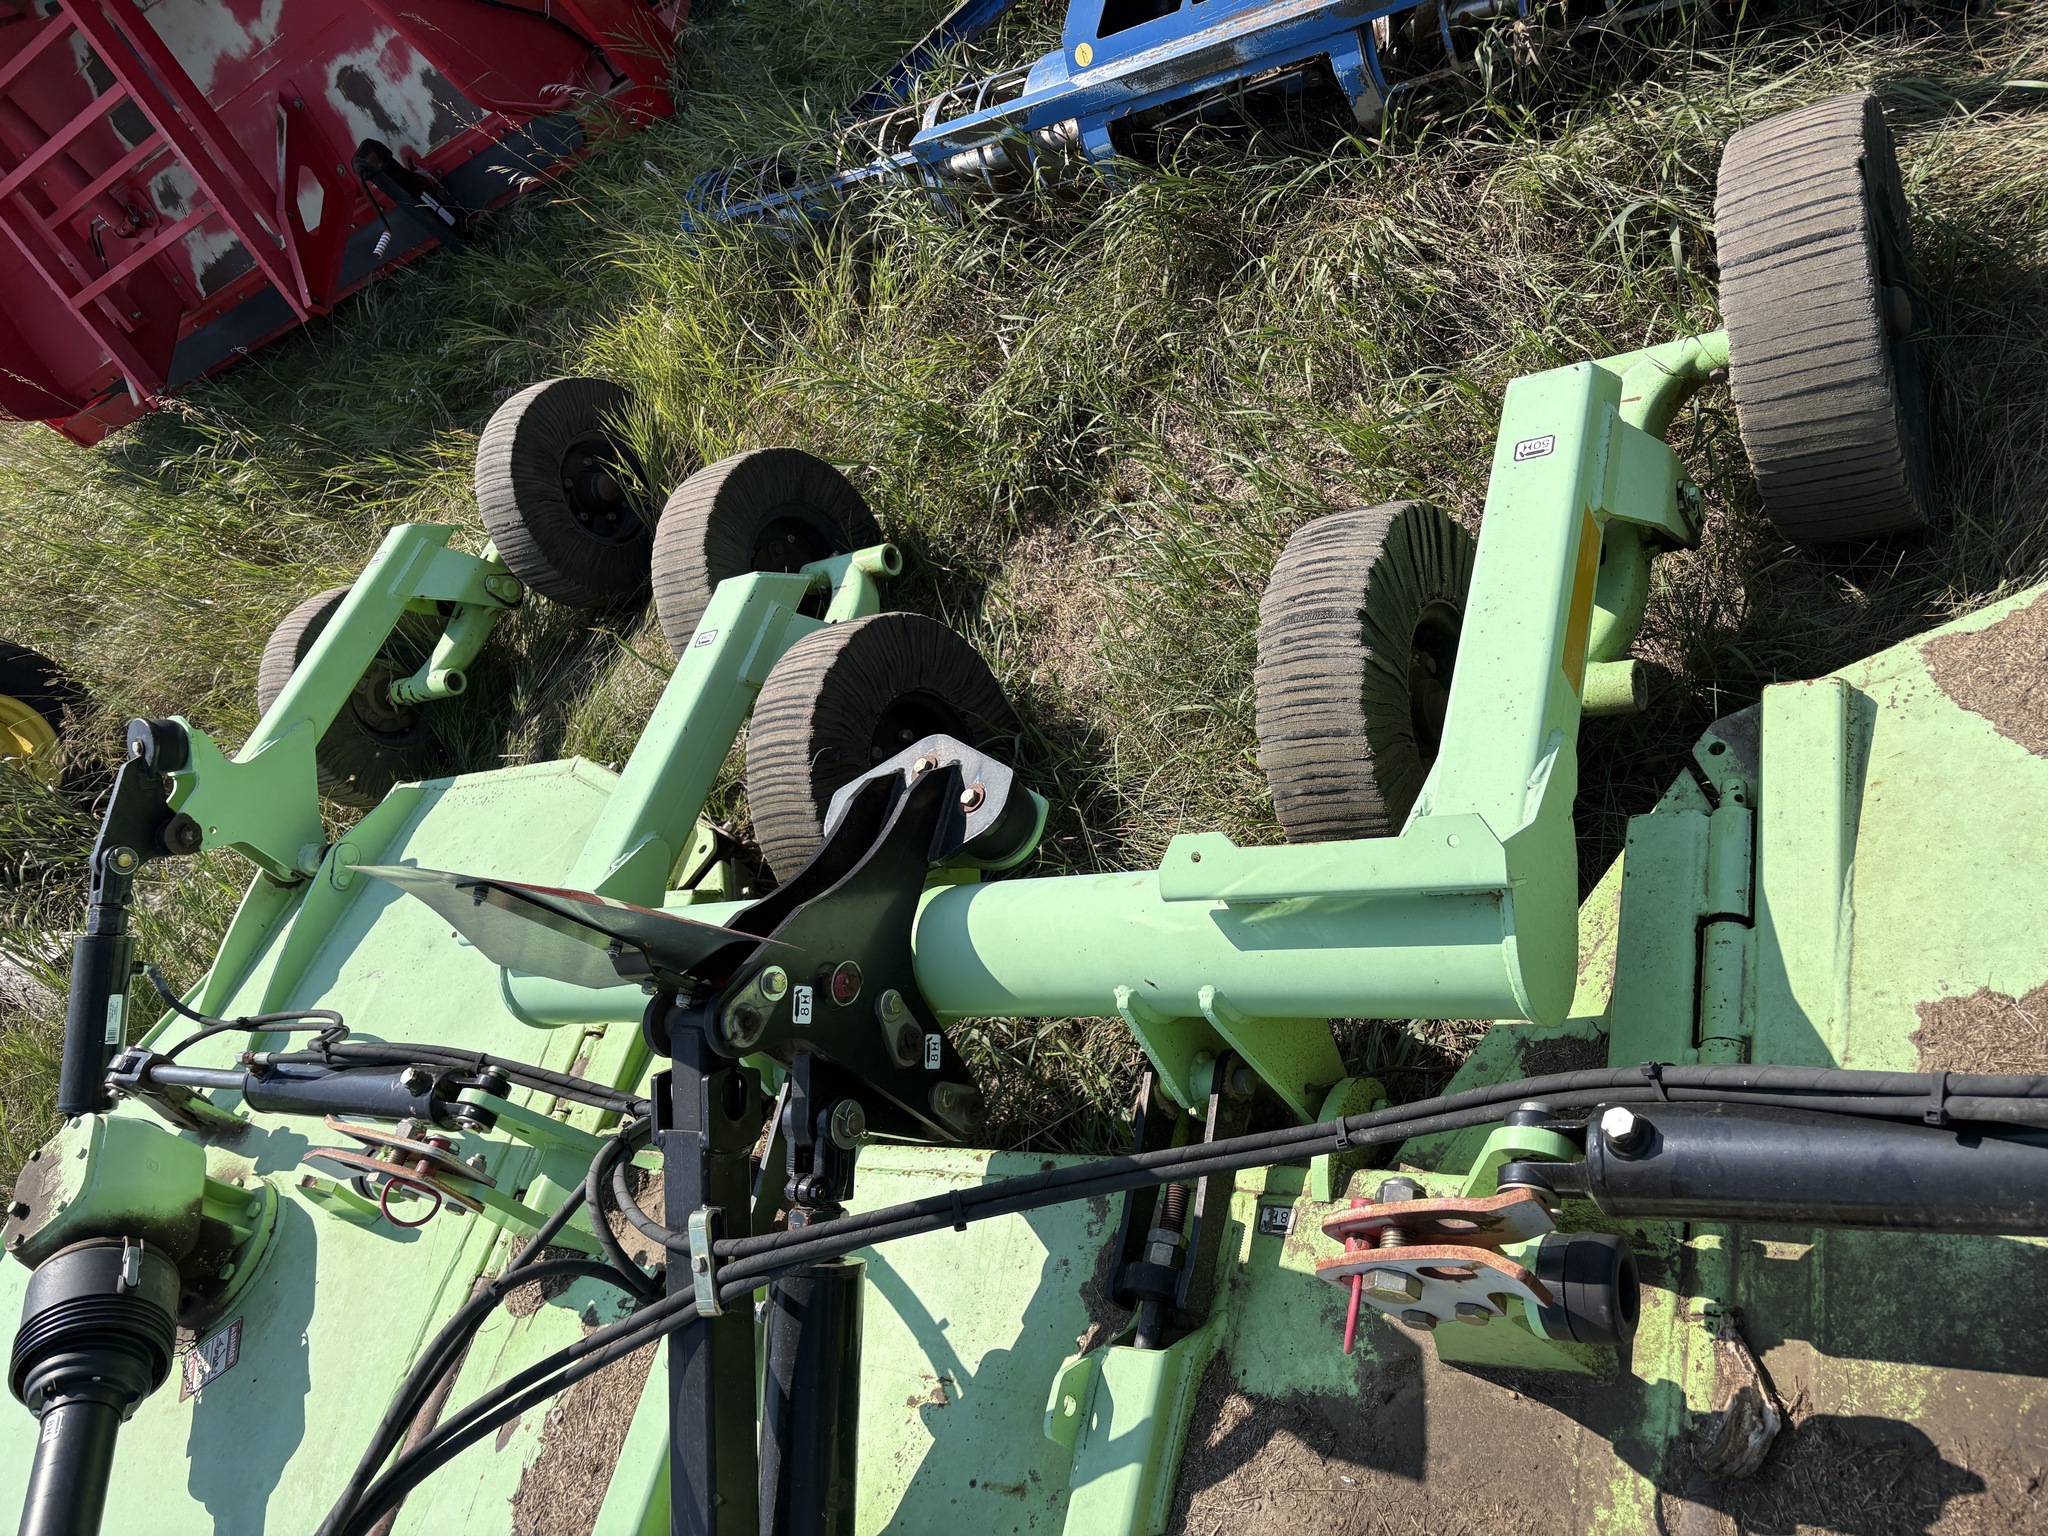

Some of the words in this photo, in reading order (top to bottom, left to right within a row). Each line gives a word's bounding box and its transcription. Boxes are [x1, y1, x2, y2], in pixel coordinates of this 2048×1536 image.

[800, 1007, 809, 1016] 8
[931, 1054, 939, 1062] 8
[1281, 1211, 1288, 1223] 8
